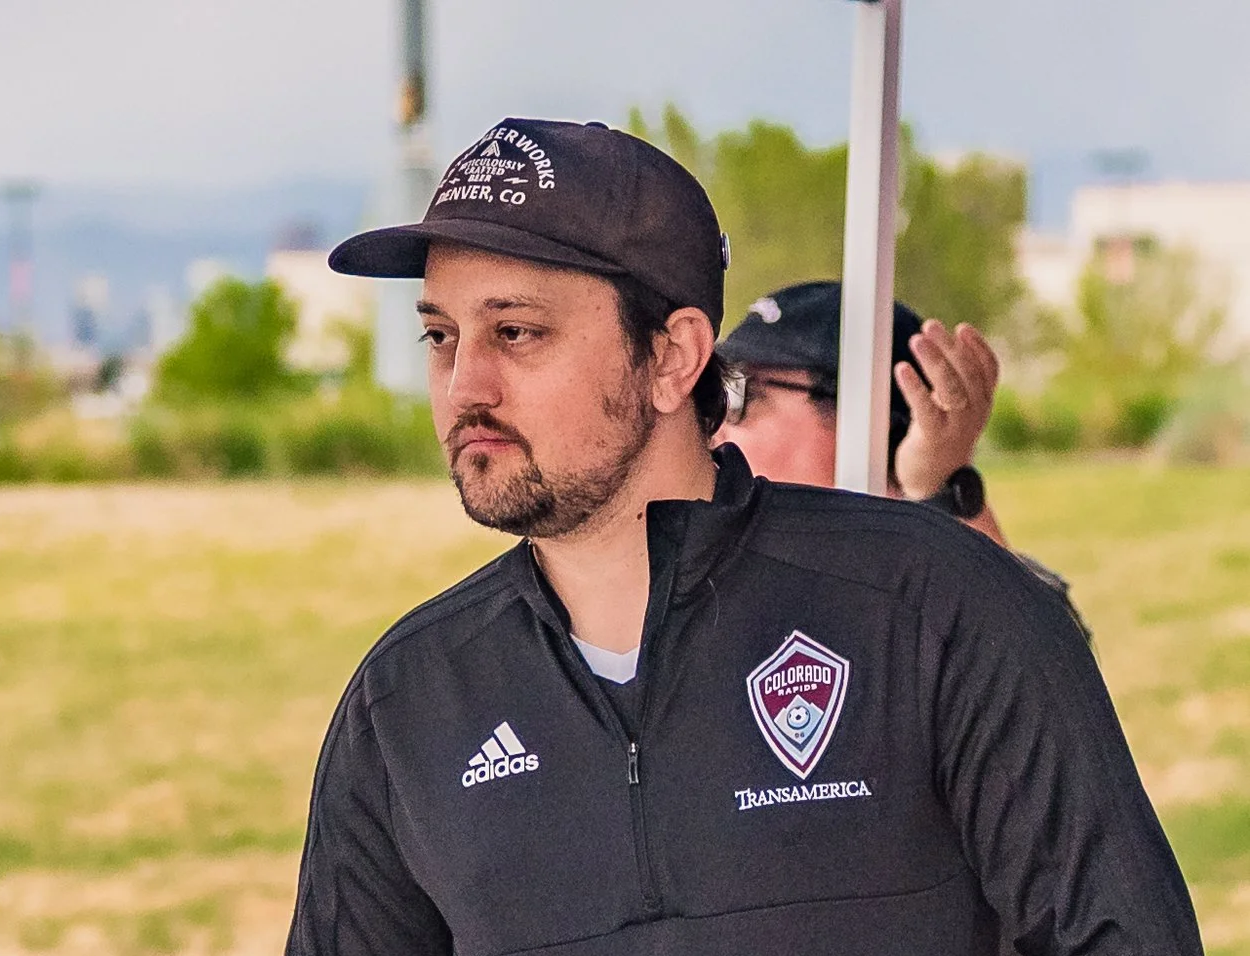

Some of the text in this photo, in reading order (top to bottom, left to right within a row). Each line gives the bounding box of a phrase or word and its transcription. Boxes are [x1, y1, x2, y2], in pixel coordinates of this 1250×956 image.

[465, 166, 505, 176] CRAFTED
[468, 174, 492, 182] BEER
[500, 189, 526, 205] CO
[764, 665, 831, 695] COLORADO
[777, 683, 817, 696] RAPIDS
[462, 754, 539, 787] adidas
[735, 781, 872, 811] TRANSAMERICA
